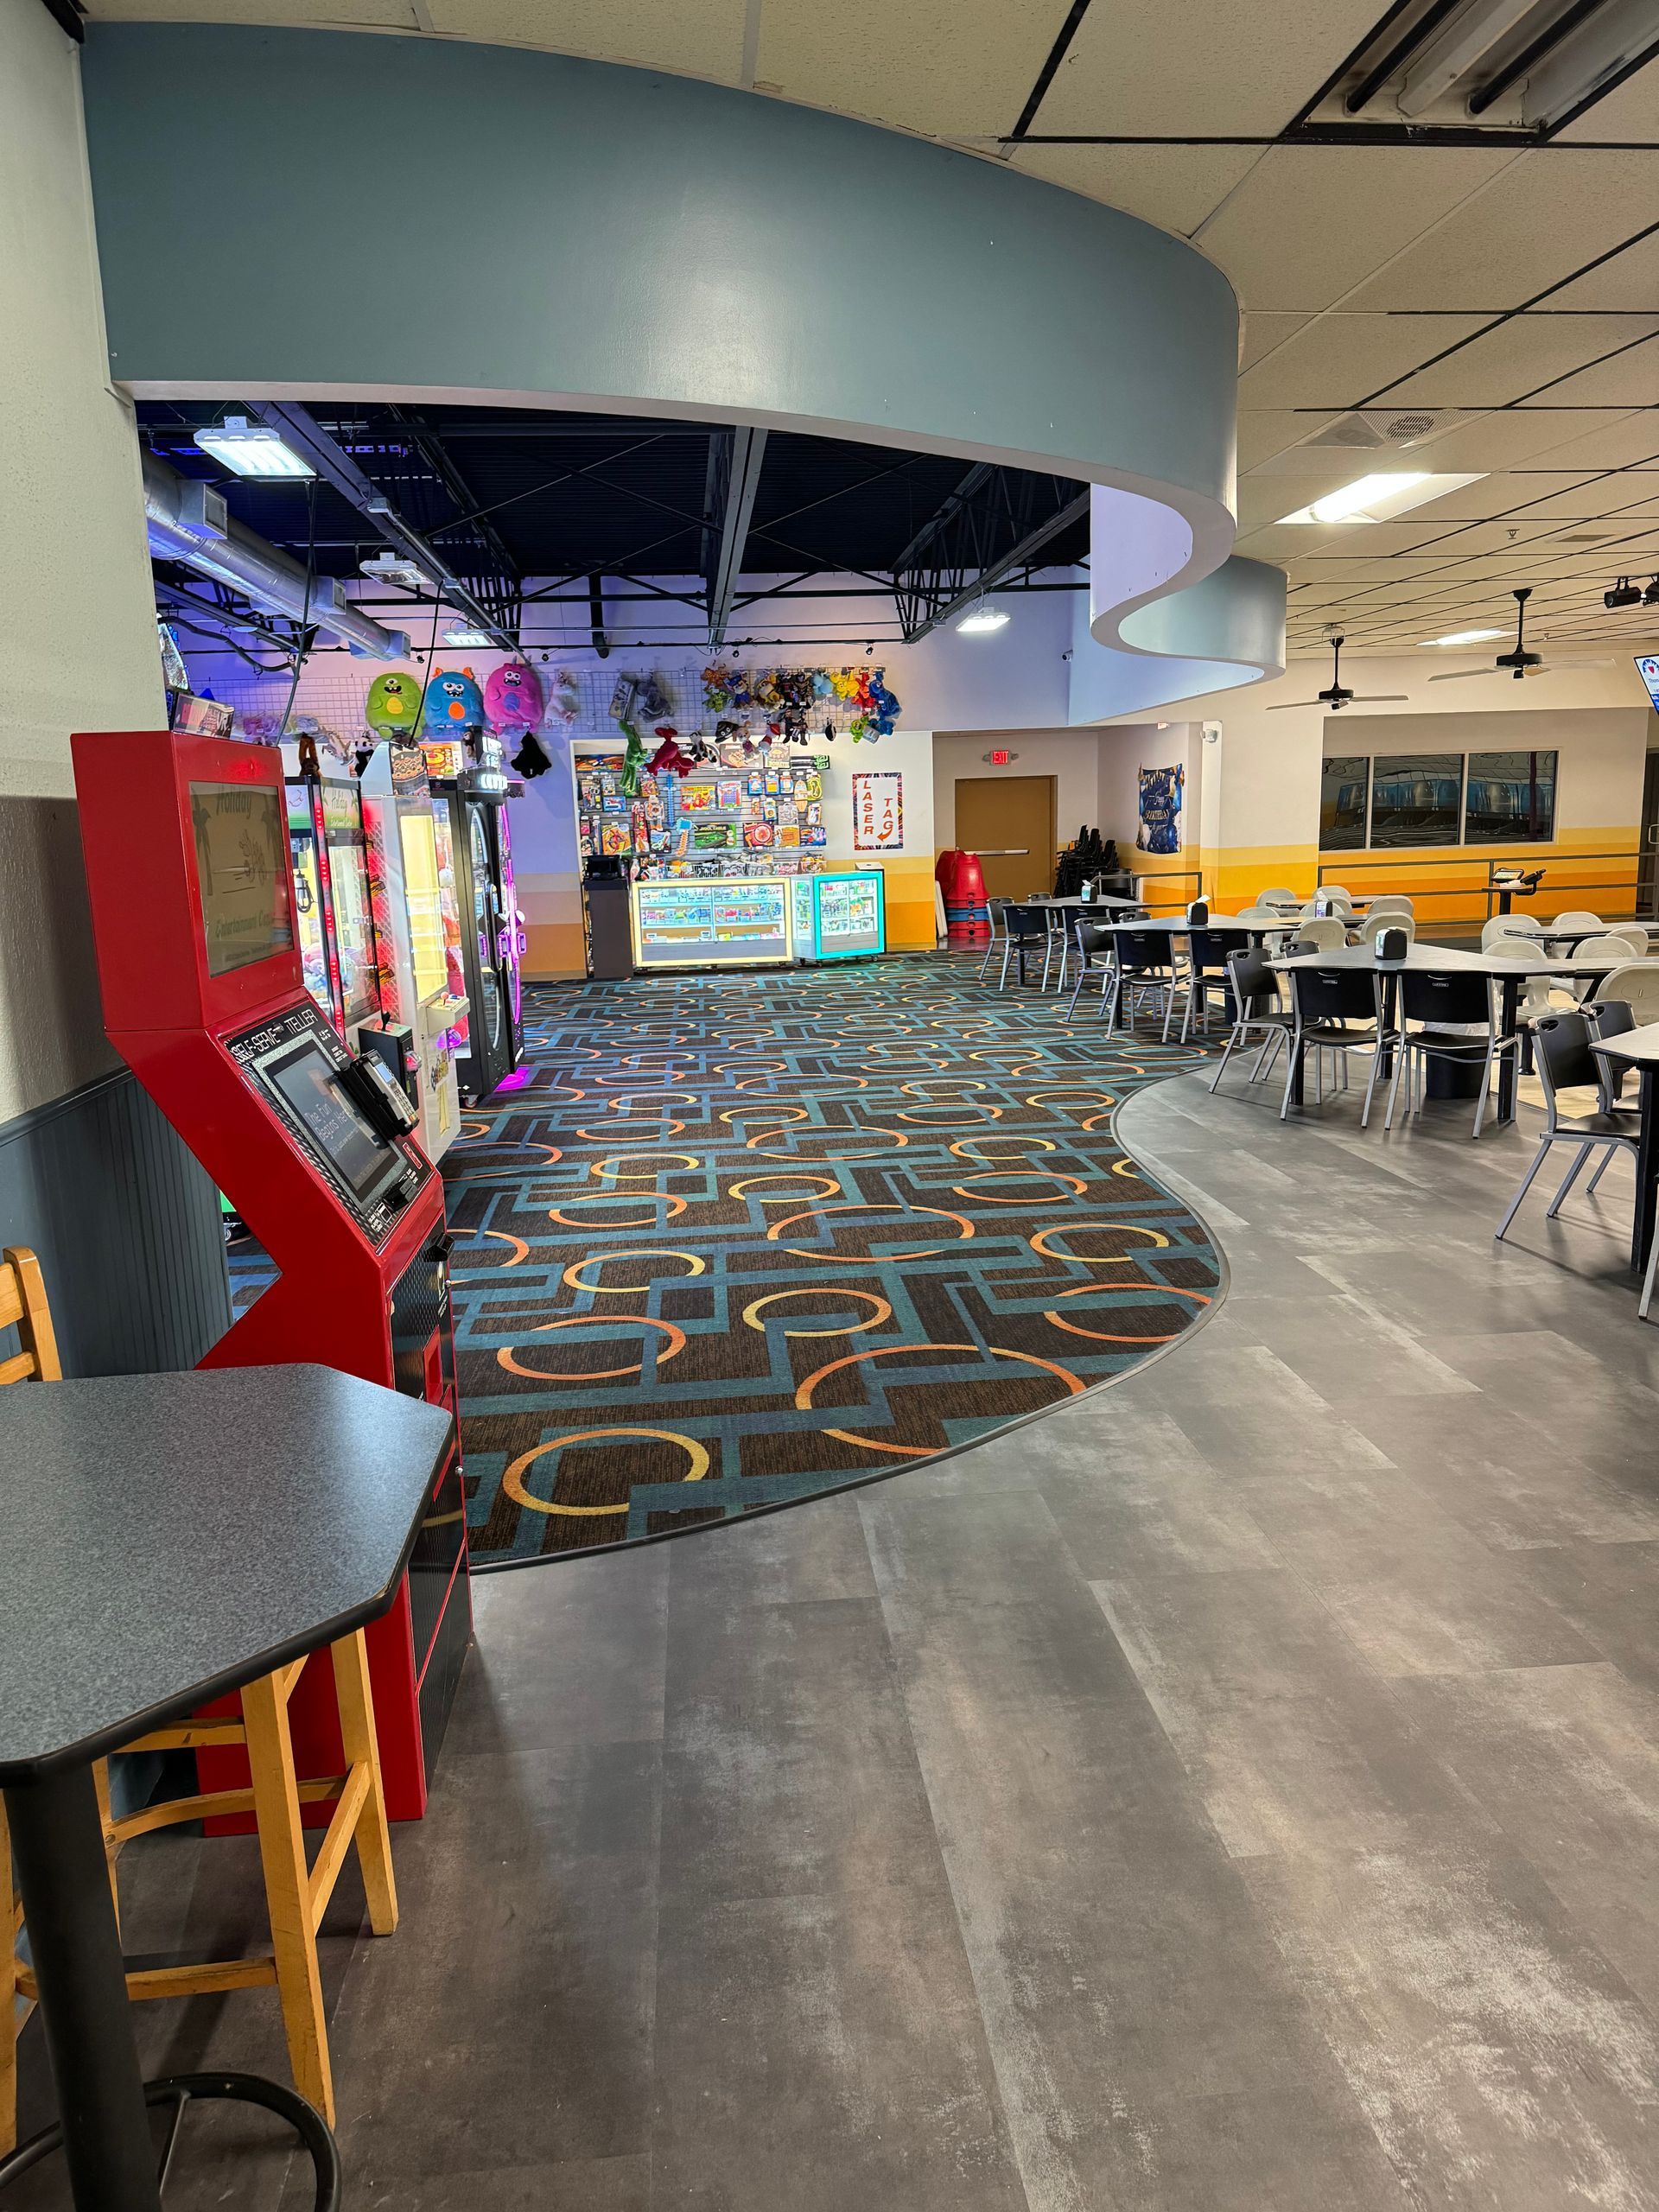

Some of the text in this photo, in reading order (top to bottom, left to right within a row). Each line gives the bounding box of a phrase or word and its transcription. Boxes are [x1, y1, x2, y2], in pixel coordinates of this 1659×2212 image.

[993, 751, 1009, 764] EXIT
[862, 780, 874, 835] LASER
[882, 798, 894, 830] TAG
[230, 1027, 281, 1064] SELF-SERVE
[303, 1103, 333, 1126] The Fun
[315, 1119, 340, 1141] Begins
